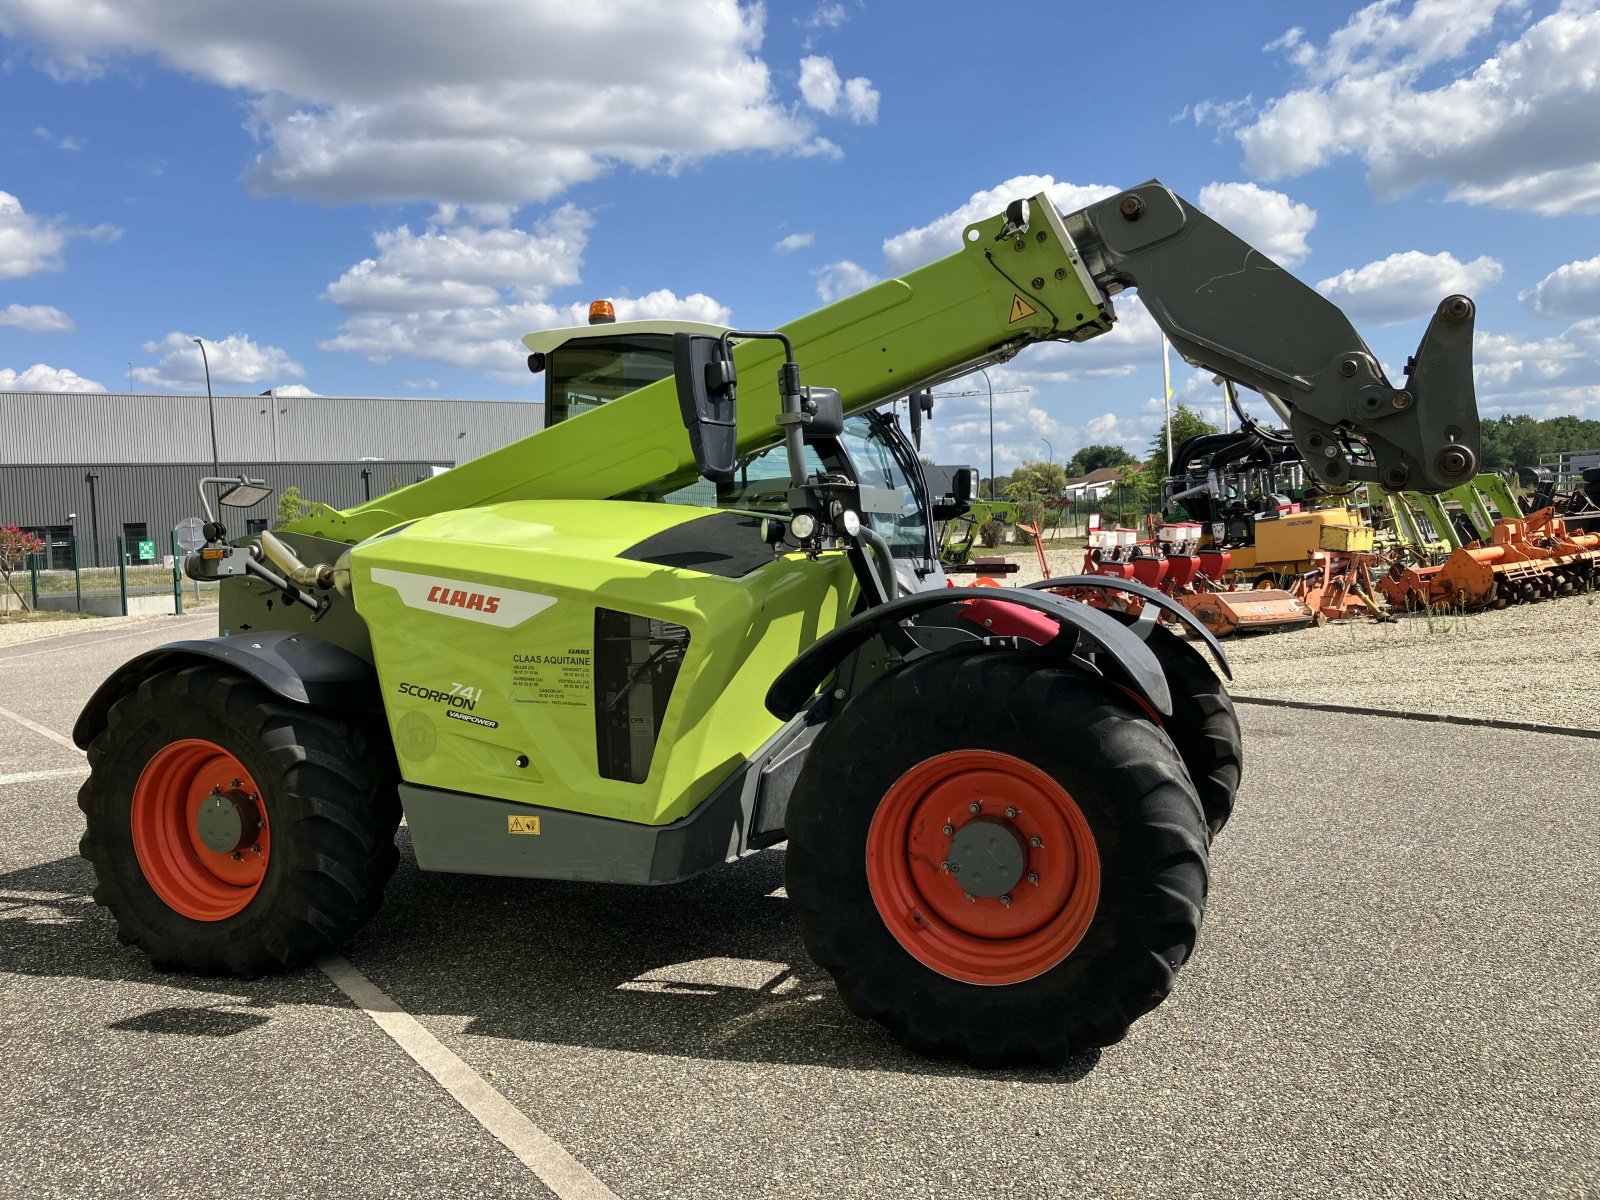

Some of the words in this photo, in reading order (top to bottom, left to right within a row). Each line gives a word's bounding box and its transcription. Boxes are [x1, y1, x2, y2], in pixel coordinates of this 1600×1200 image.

[427, 586, 501, 614] CLAAS
[513, 654, 542, 664] CLAAS
[543, 655, 591, 666] AQUITAINE
[398, 682, 476, 711] SCORPION
[449, 682, 483, 702] 741
[448, 710, 496, 728] VARIPOWER
